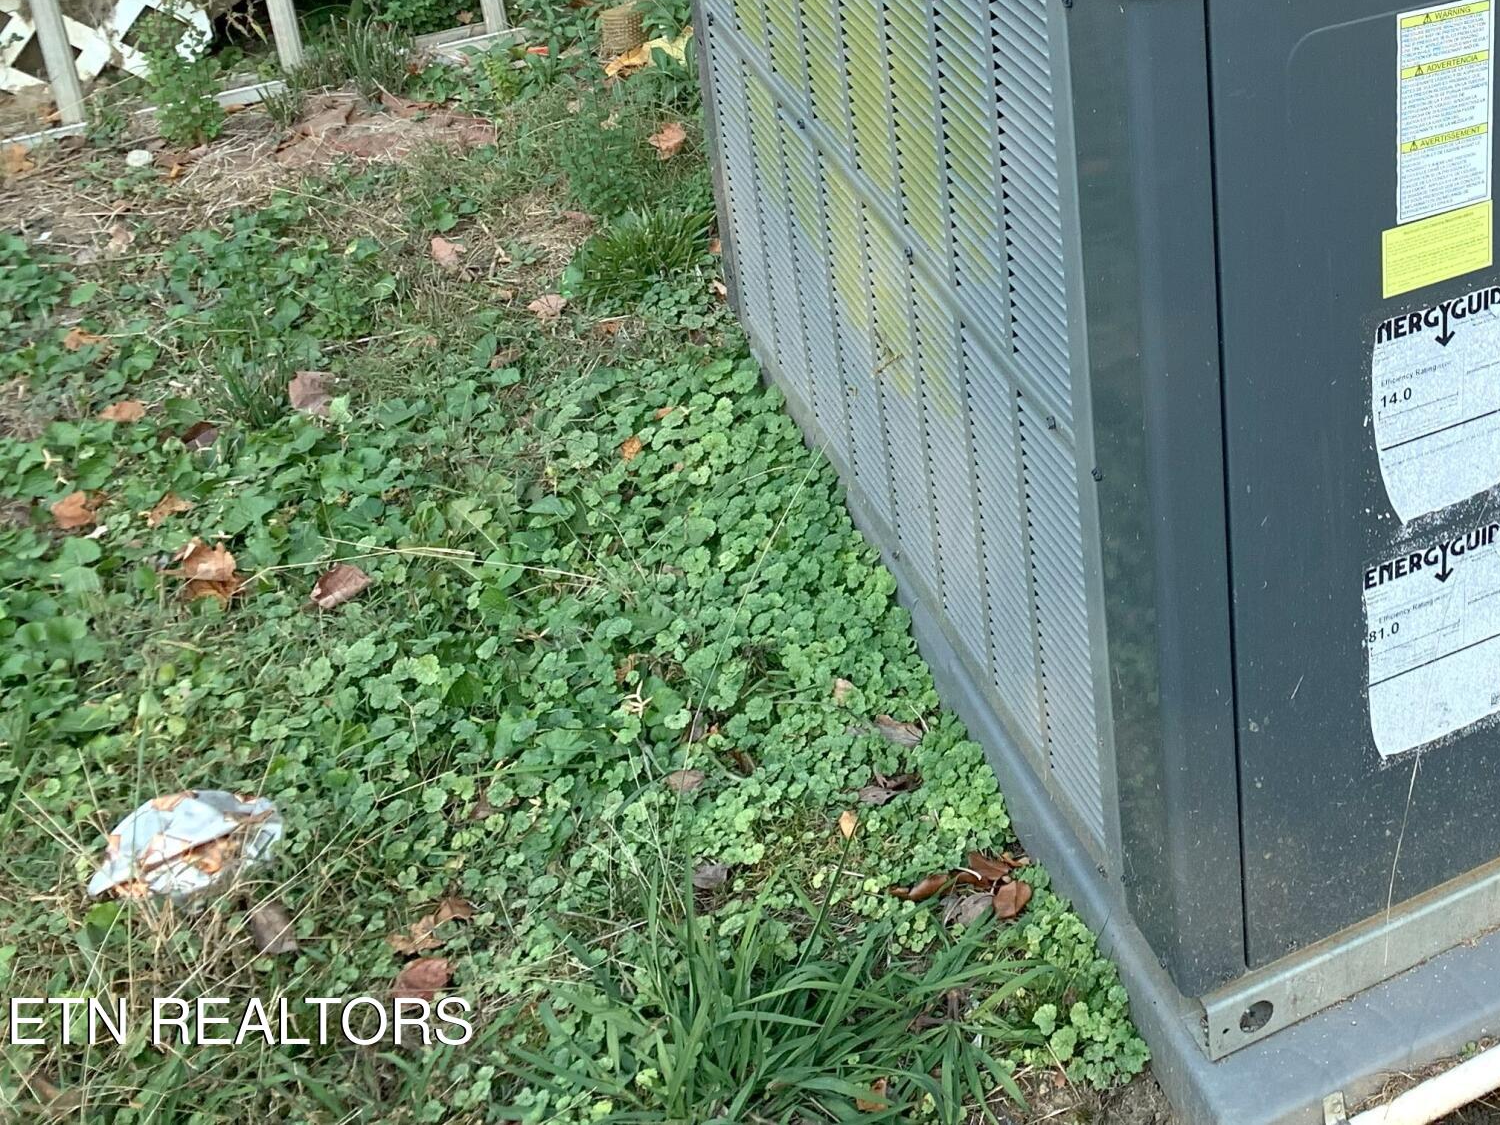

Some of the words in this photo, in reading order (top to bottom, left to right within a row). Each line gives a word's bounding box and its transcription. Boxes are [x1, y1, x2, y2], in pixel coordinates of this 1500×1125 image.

[1435, 5, 1471, 19] WARNING
[1427, 54, 1478, 72] ADVERTENCIA
[1420, 126, 1480, 147] AVERTISSEMENT
[1416, 365, 1436, 375] Rating
[1381, 388, 1412, 407] 14.0
[1369, 622, 1400, 643] 81.0
